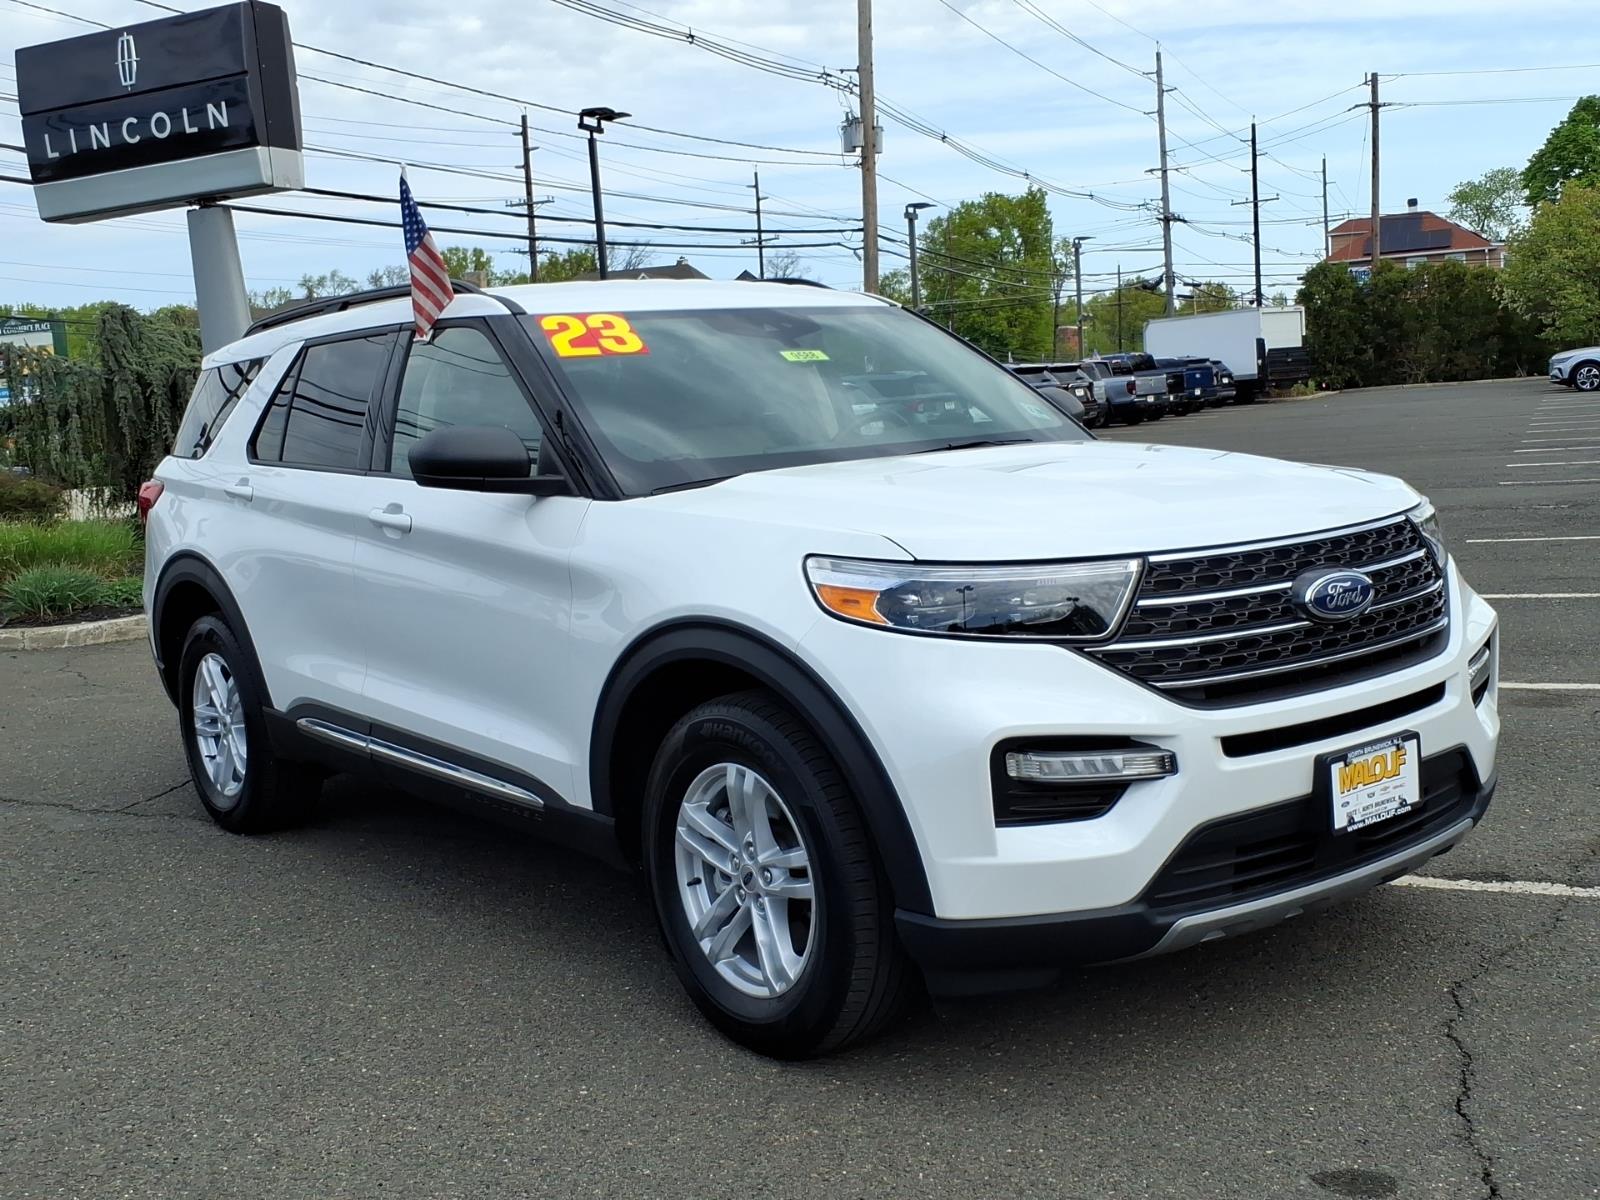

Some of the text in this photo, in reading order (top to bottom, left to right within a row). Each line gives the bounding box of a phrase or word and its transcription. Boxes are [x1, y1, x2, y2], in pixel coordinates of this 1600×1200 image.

[44, 100, 230, 159] LINCOLN
[541, 314, 644, 358] 23
[1326, 581, 1363, 609] Ford
[1339, 749, 1406, 794] MALOUF
[1347, 805, 1412, 832] www.MALOUF.com
